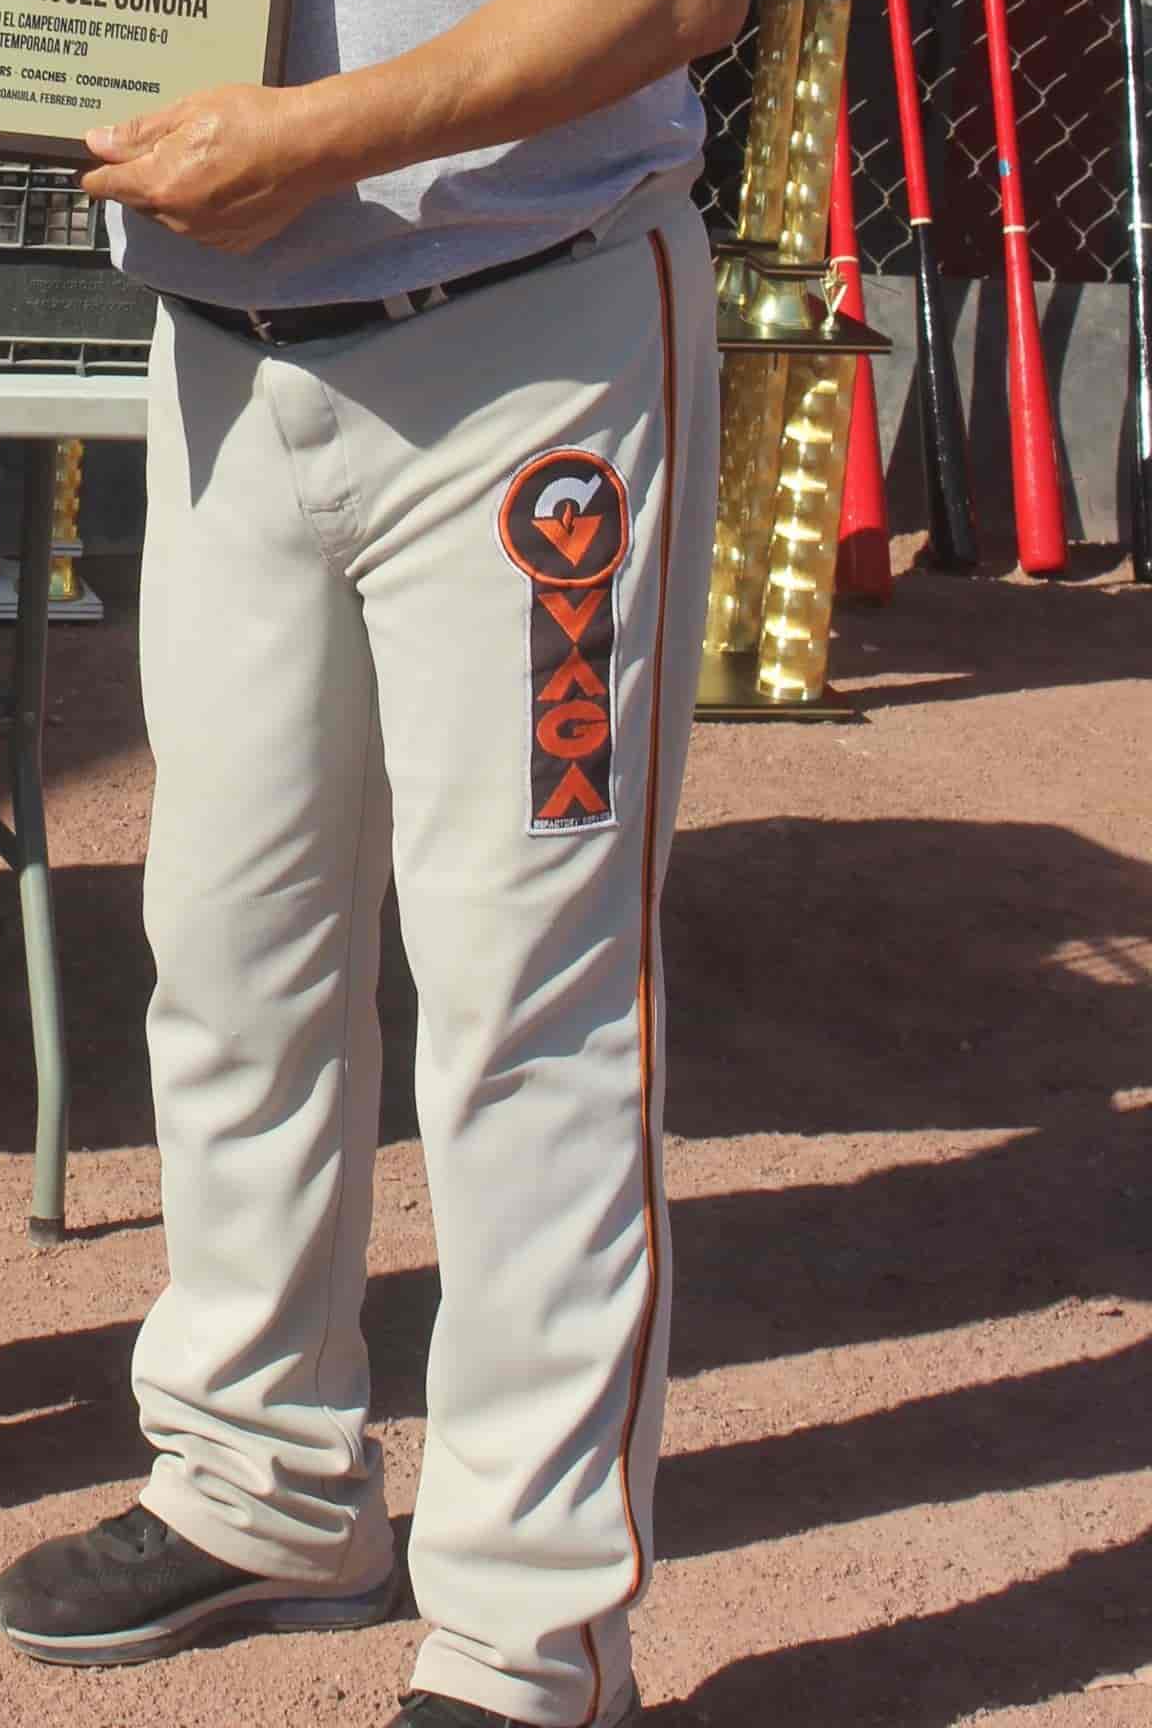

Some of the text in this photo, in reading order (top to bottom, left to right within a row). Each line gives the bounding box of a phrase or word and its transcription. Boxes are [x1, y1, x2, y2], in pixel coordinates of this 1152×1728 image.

[3, 10, 16, 28] EL
[18, 12, 87, 36] CAMPEONATO
[88, 20, 102, 37] DE
[104, 21, 148, 43] PITCHEO
[149, 27, 168, 45] 6-0
[0, 32, 60, 53] TEMPORADA
[21, 67, 67, 83] COACHES
[76, 74, 161, 94] COORDINADORES
[40, 92, 77, 107] FEBRERO
[79, 97, 101, 110] 2023
